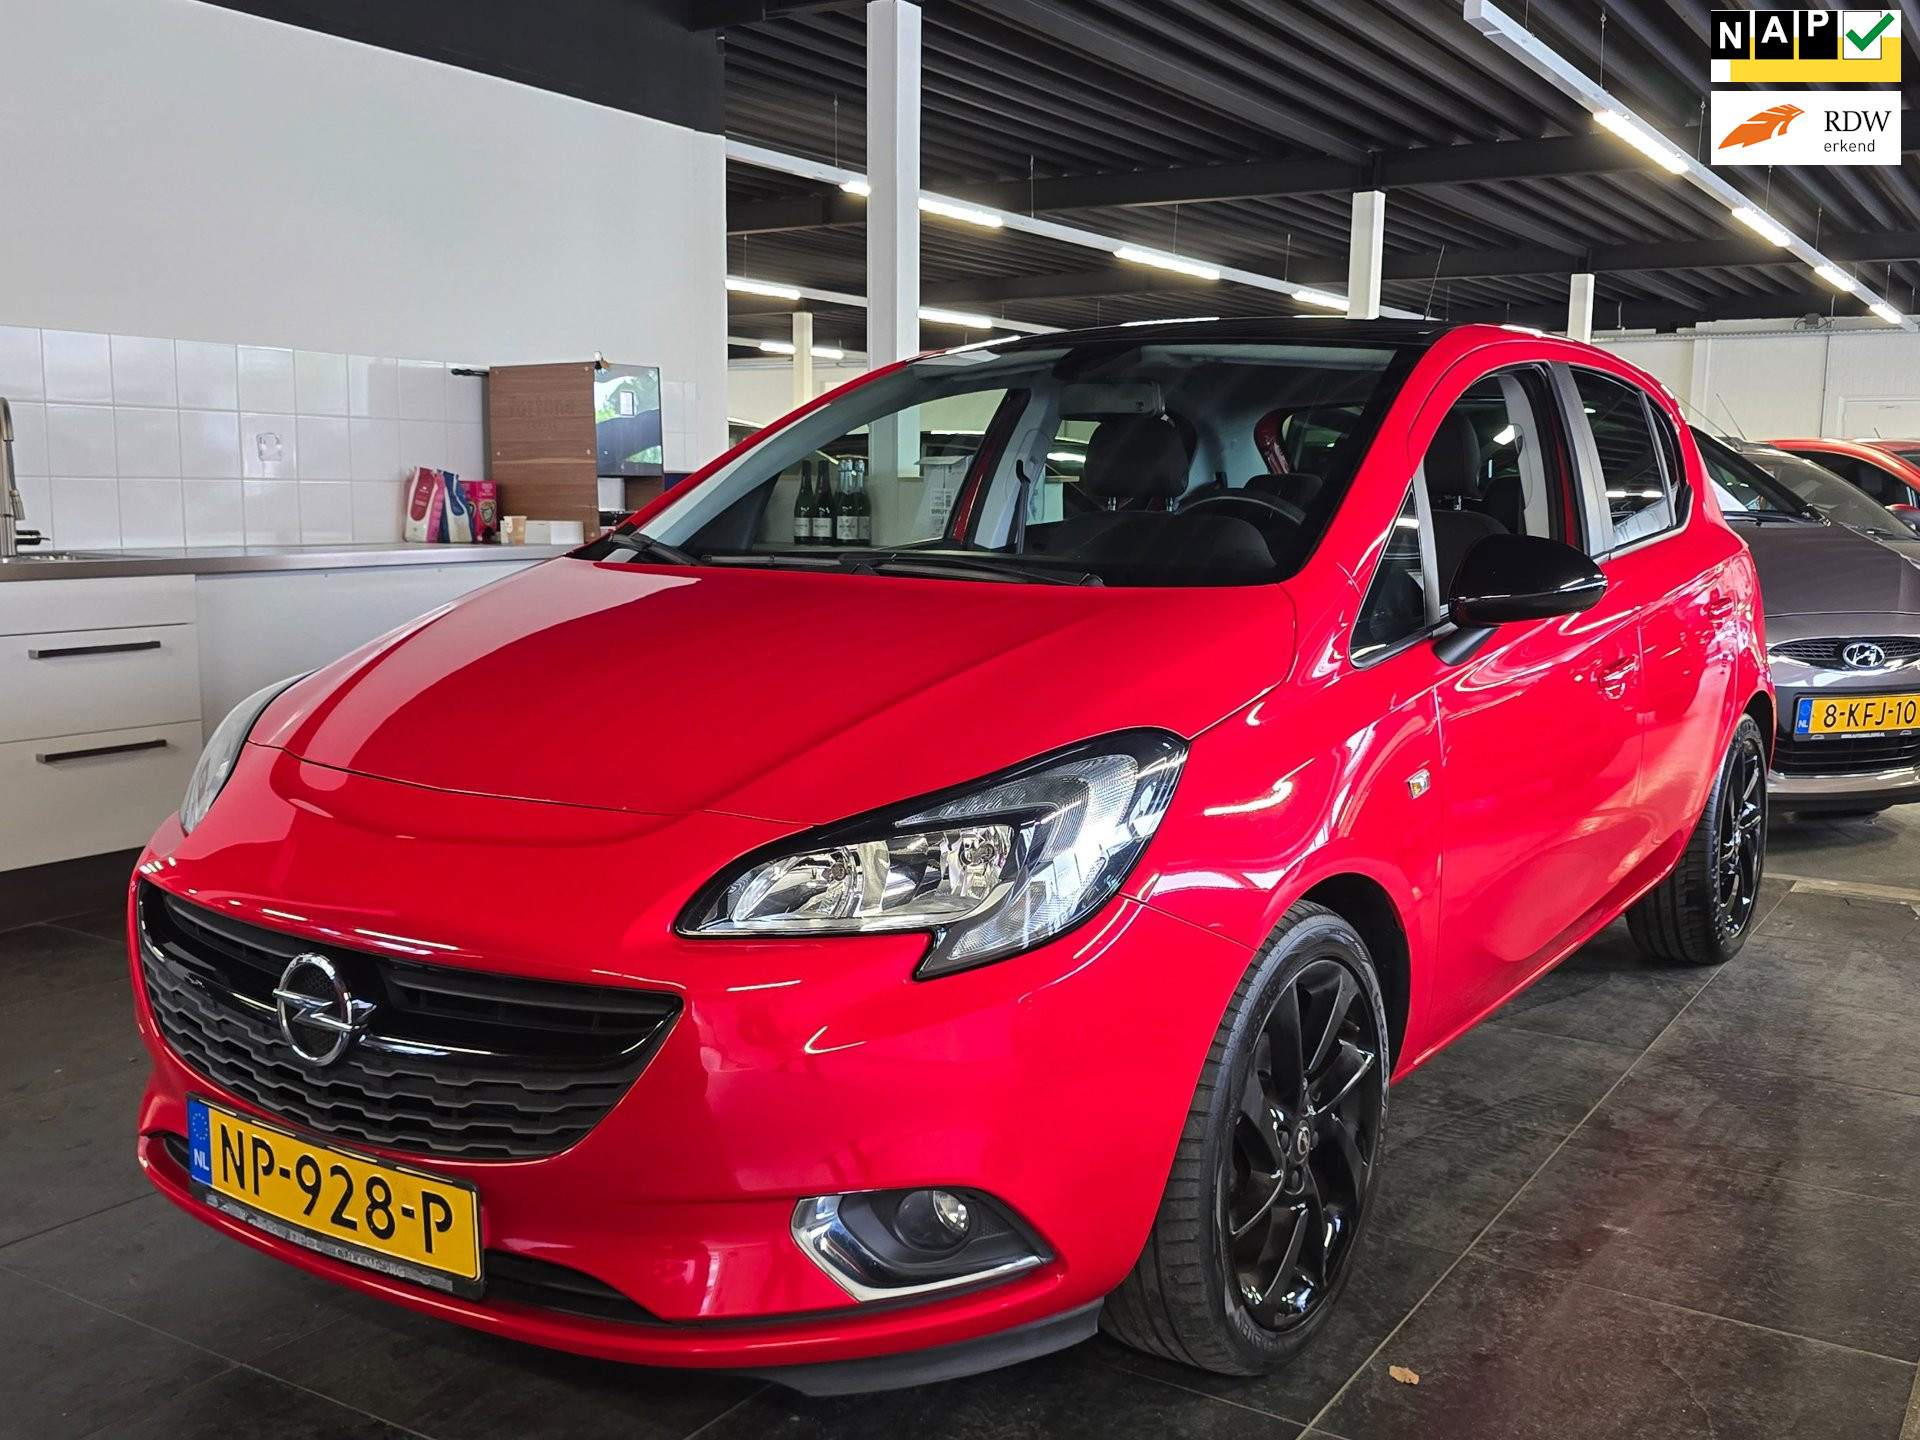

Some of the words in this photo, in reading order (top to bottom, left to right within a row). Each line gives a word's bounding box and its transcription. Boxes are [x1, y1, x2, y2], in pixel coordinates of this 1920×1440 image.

[1798, 719, 1808, 728] NL
[1823, 700, 1917, 729] 8-KFJ-10
[193, 1148, 210, 1172] NL
[220, 1123, 454, 1254] NP-928-P
